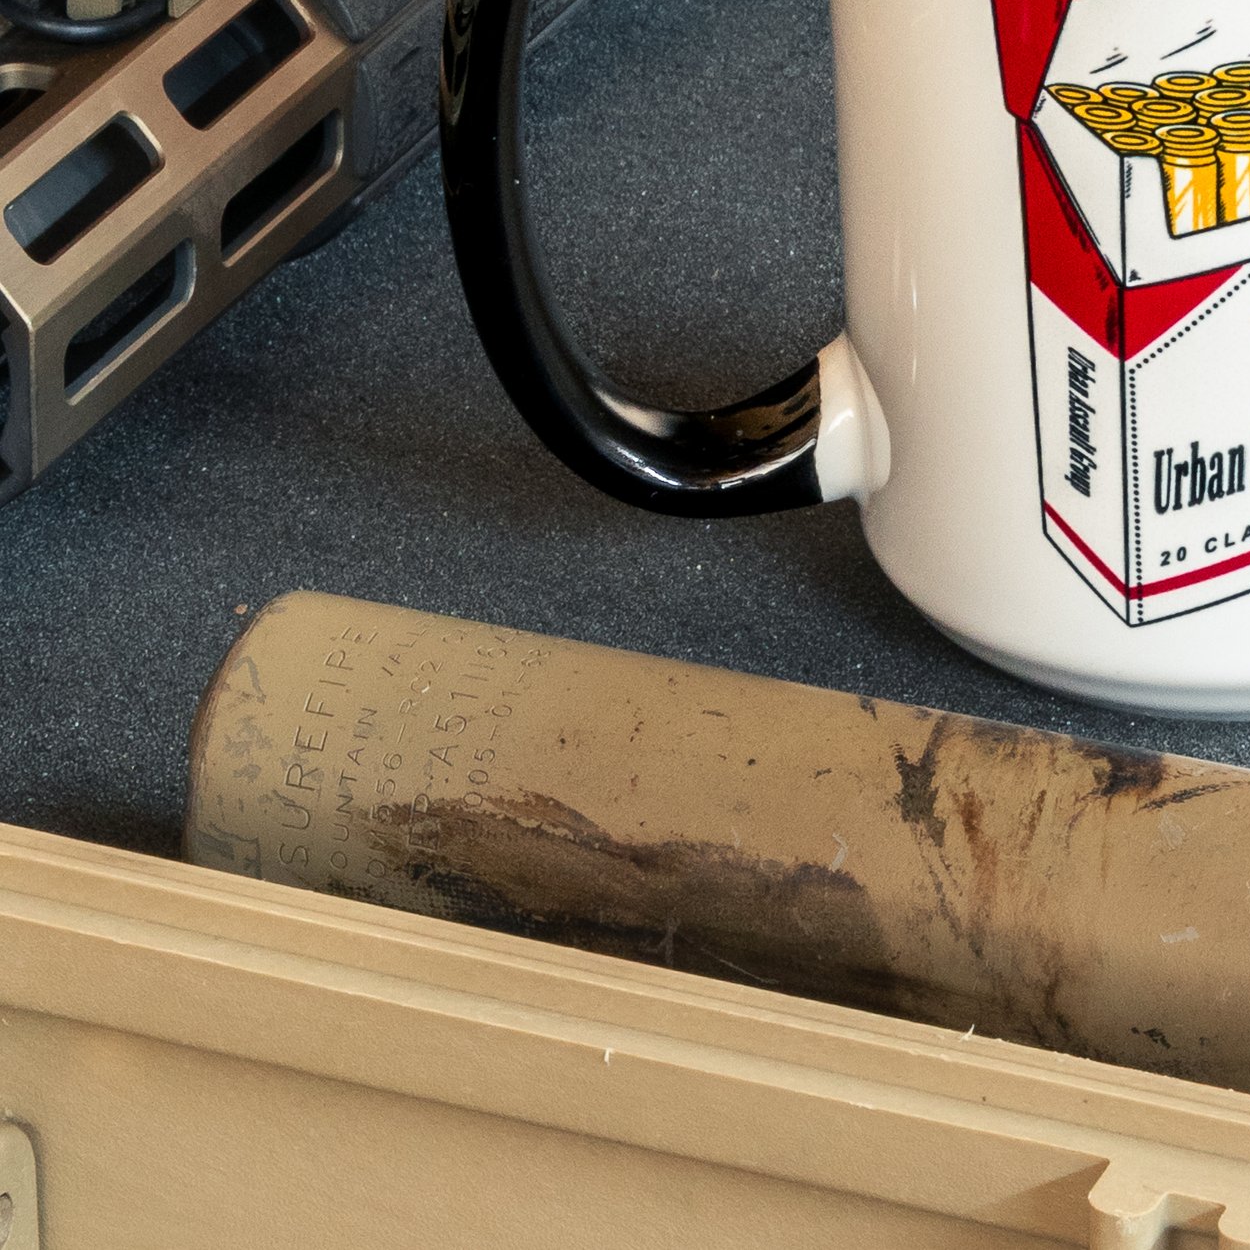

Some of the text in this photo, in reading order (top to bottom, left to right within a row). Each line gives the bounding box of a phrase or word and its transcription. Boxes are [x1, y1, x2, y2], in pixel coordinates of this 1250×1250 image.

[1068, 390, 1098, 457] Assault
[1153, 440, 1247, 515] Urban
[1160, 546, 1188, 567] 20
[277, 625, 379, 868] SUREFIRE
